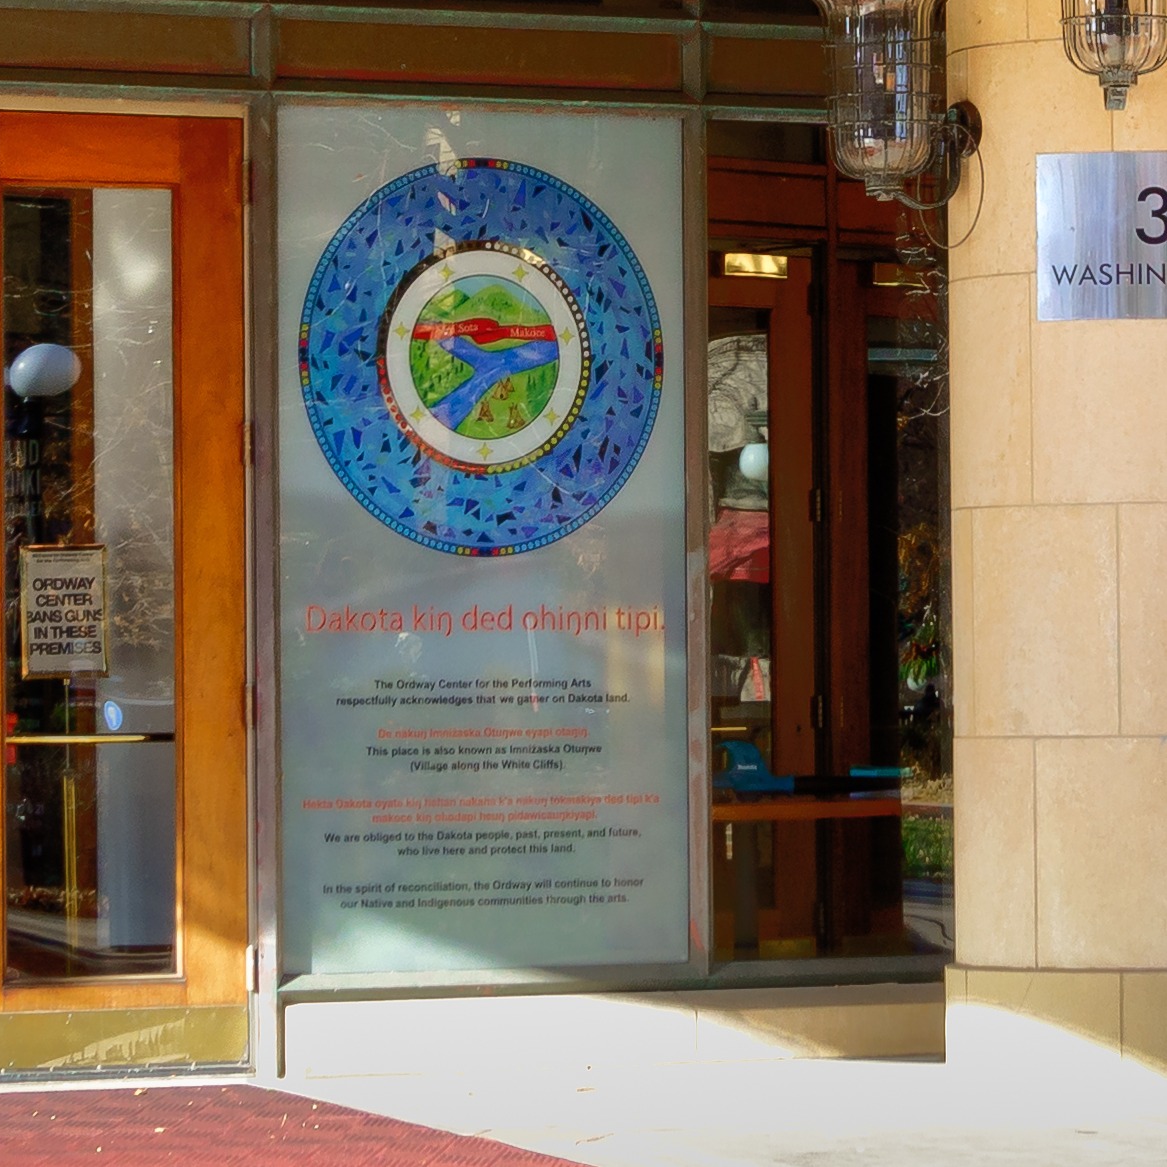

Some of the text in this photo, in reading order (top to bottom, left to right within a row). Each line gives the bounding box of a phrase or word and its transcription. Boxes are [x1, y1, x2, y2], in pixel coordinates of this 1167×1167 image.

[32, 577, 95, 591] ORDWAY
[35, 593, 93, 607] CENTER
[305, 604, 403, 632] Dakota
[461, 604, 513, 632] ded
[34, 625, 97, 639] IN THESE
[30, 641, 102, 656] PREMISES
[374, 678, 591, 690] The Ordway Center for the Performing Arts
[336, 696, 396, 707] respectfully
[399, 695, 472, 706] acknowledges
[476, 695, 495, 704] that
[552, 696, 564, 704] on
[568, 694, 602, 703] Dakota
[366, 746, 388, 755] This
[391, 746, 418, 757] place
[422, 746, 430, 755] is
[434, 745, 455, 755] also
[458, 745, 491, 754] known
[410, 761, 447, 772] (Village
[451, 761, 479, 772] along
[482, 760, 498, 770] the
[501, 760, 530, 769] White
[324, 833, 340, 842] We
[363, 832, 401, 843] obliged
[404, 832, 414, 841] to
[417, 831, 433, 841] the
[436, 831, 472, 840] Dakota
[587, 828, 605, 838] and
[397, 846, 419, 856] who
[422, 846, 439, 855] live
[442, 846, 465, 855] here
[468, 845, 487, 855] and
[490, 845, 525, 856] protect
[529, 844, 547, 854] this
[323, 884, 332, 893] In
[335, 883, 352, 893] the
[355, 883, 381, 894] spirit
[384, 882, 395, 892] of
[473, 881, 489, 890] the
[492, 880, 531, 891] Ordway
[534, 879, 551, 889] will
[554, 879, 598, 888] continue
[601, 878, 611, 887] to
[614, 878, 643, 887] honor
[361, 898, 392, 908] Native
[395, 898, 414, 907] and
[417, 897, 474, 908] Indigenous
[477, 896, 542, 905] communities
[546, 895, 585, 906] through
[589, 894, 604, 903] the
